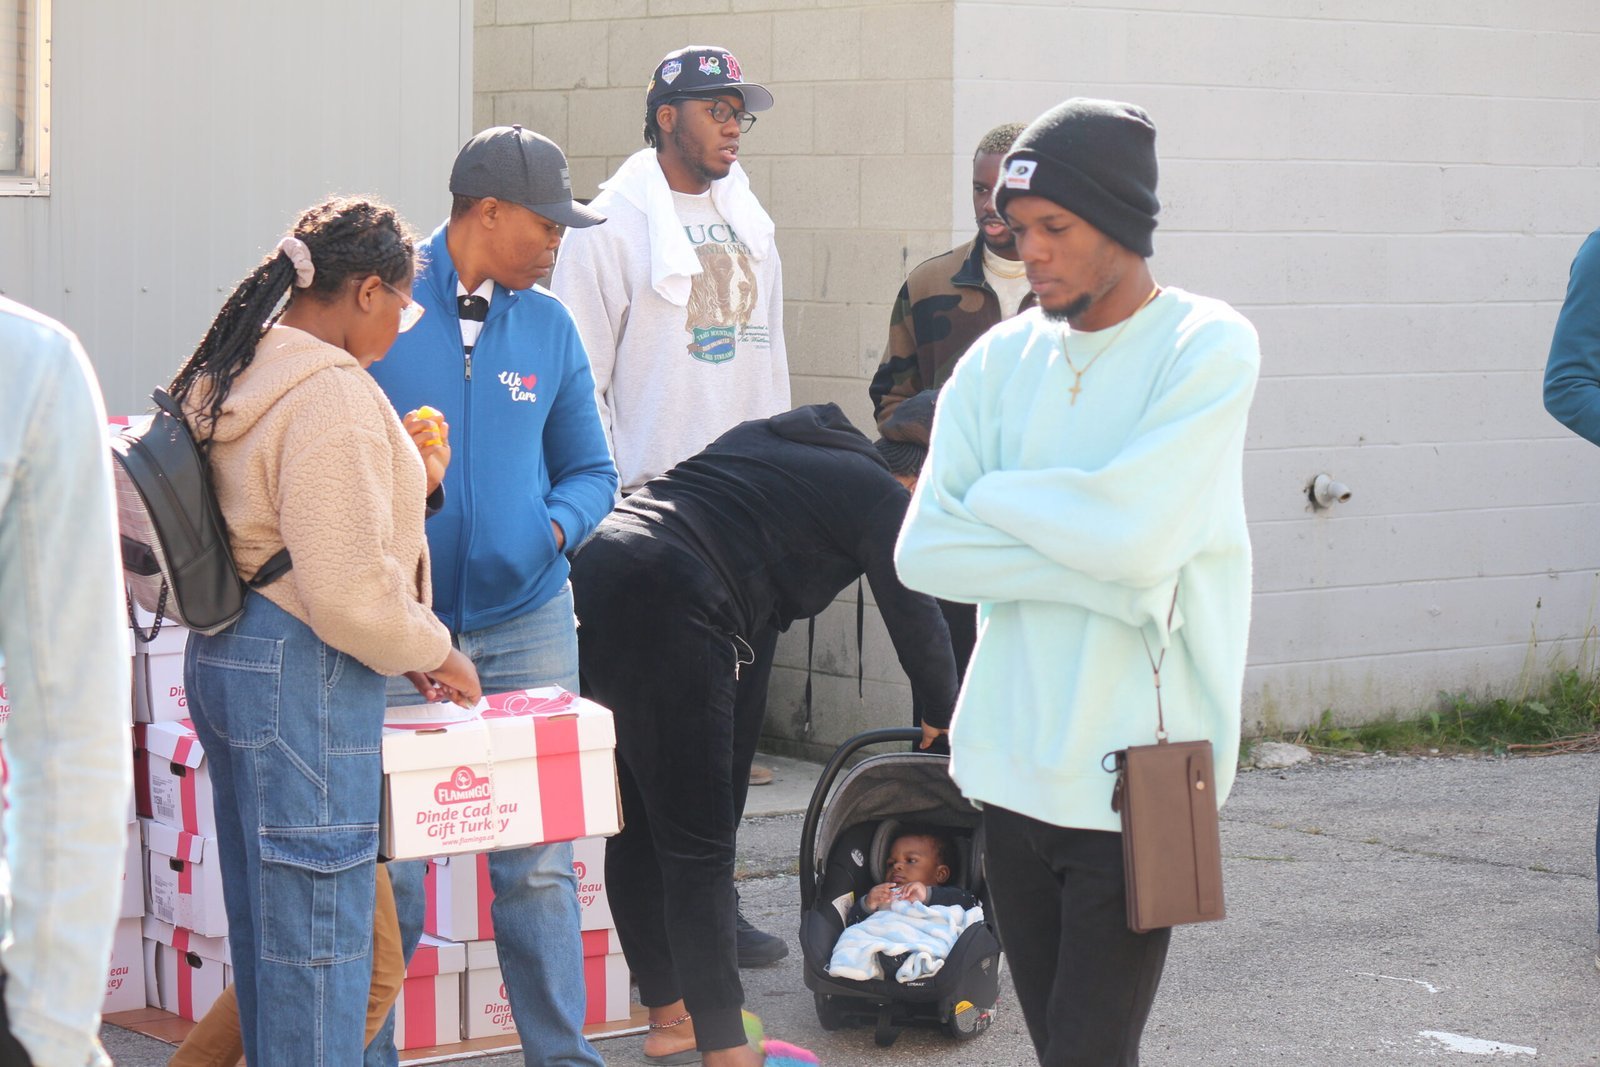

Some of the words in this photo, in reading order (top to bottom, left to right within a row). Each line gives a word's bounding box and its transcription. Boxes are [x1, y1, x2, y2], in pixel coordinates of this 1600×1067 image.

[683, 223, 742, 245] UCK
[498, 371, 522, 387] We
[508, 386, 537, 403] Care
[437, 784, 490, 802] FLAMINGO
[416, 808, 459, 825] Dinde
[463, 802, 518, 819] Cadau
[427, 822, 456, 840] Gift
[459, 817, 510, 833] Turky
